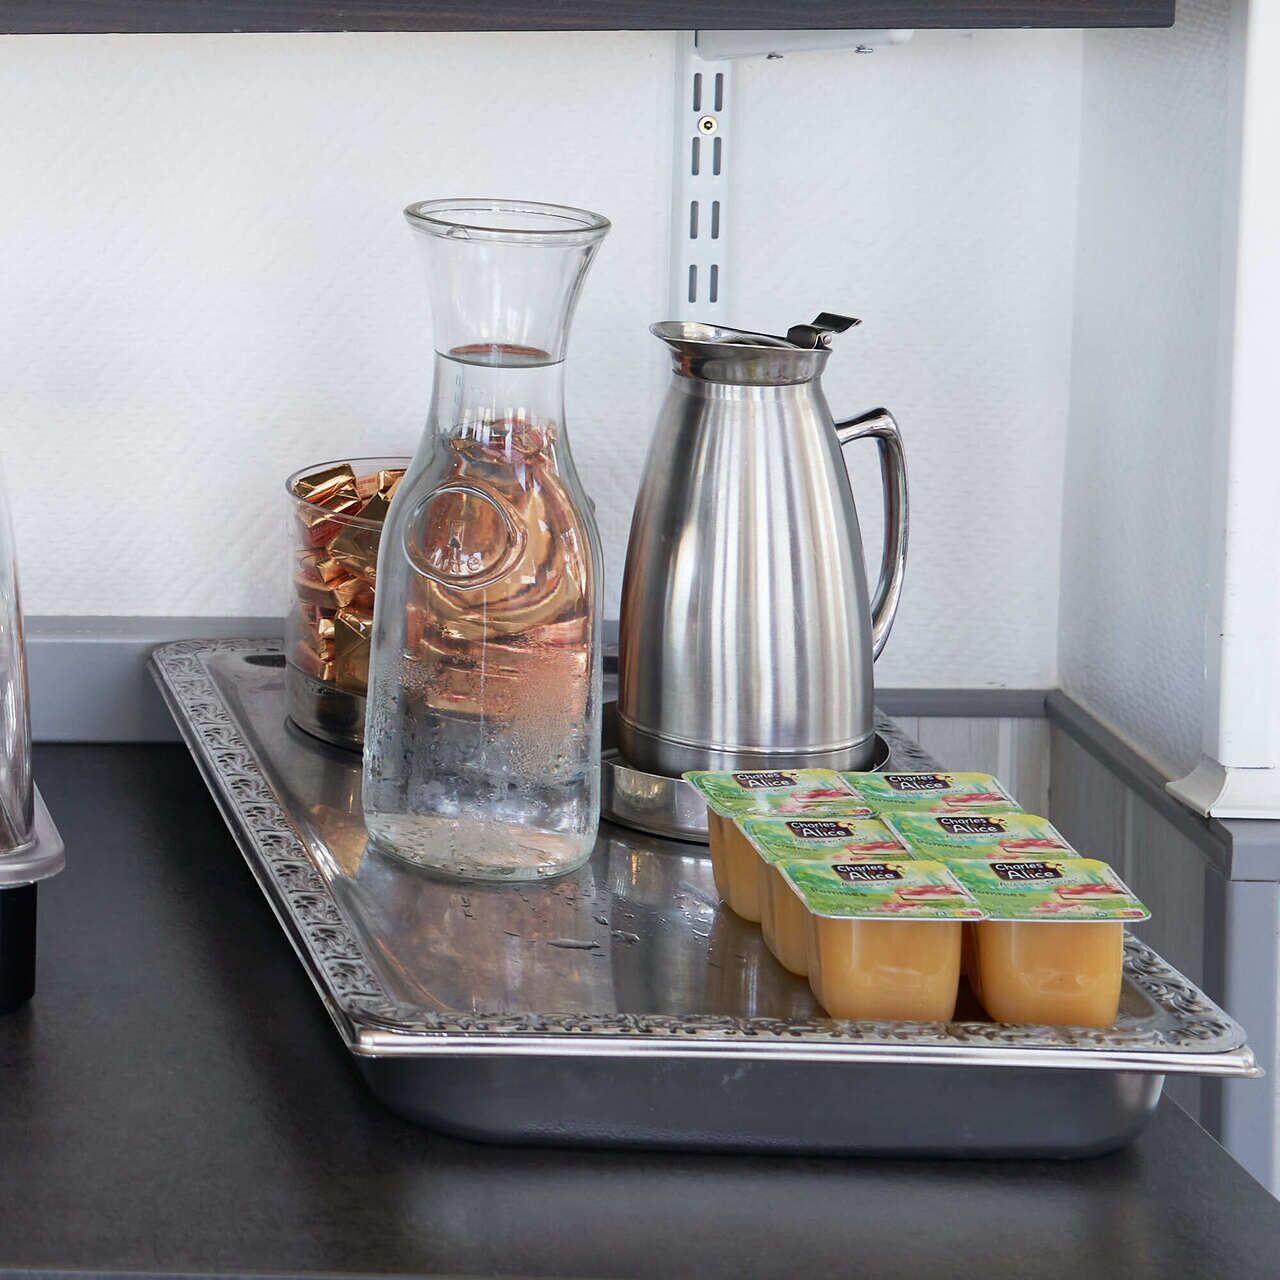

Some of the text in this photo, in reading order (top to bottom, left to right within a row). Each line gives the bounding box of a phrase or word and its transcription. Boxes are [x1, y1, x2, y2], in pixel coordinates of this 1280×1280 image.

[736, 772, 780, 780] Charles
[748, 778, 790, 788] Alice
[900, 781, 943, 790] Alice
[791, 821, 836, 829] Charles
[940, 817, 987, 825] Charles
[802, 827, 847, 838] Alice
[953, 824, 998, 833] Alice
[837, 863, 884, 872] Charles
[995, 862, 1044, 871] Charles
[849, 871, 894, 881] Alice
[1007, 869, 1055, 880] Alice
